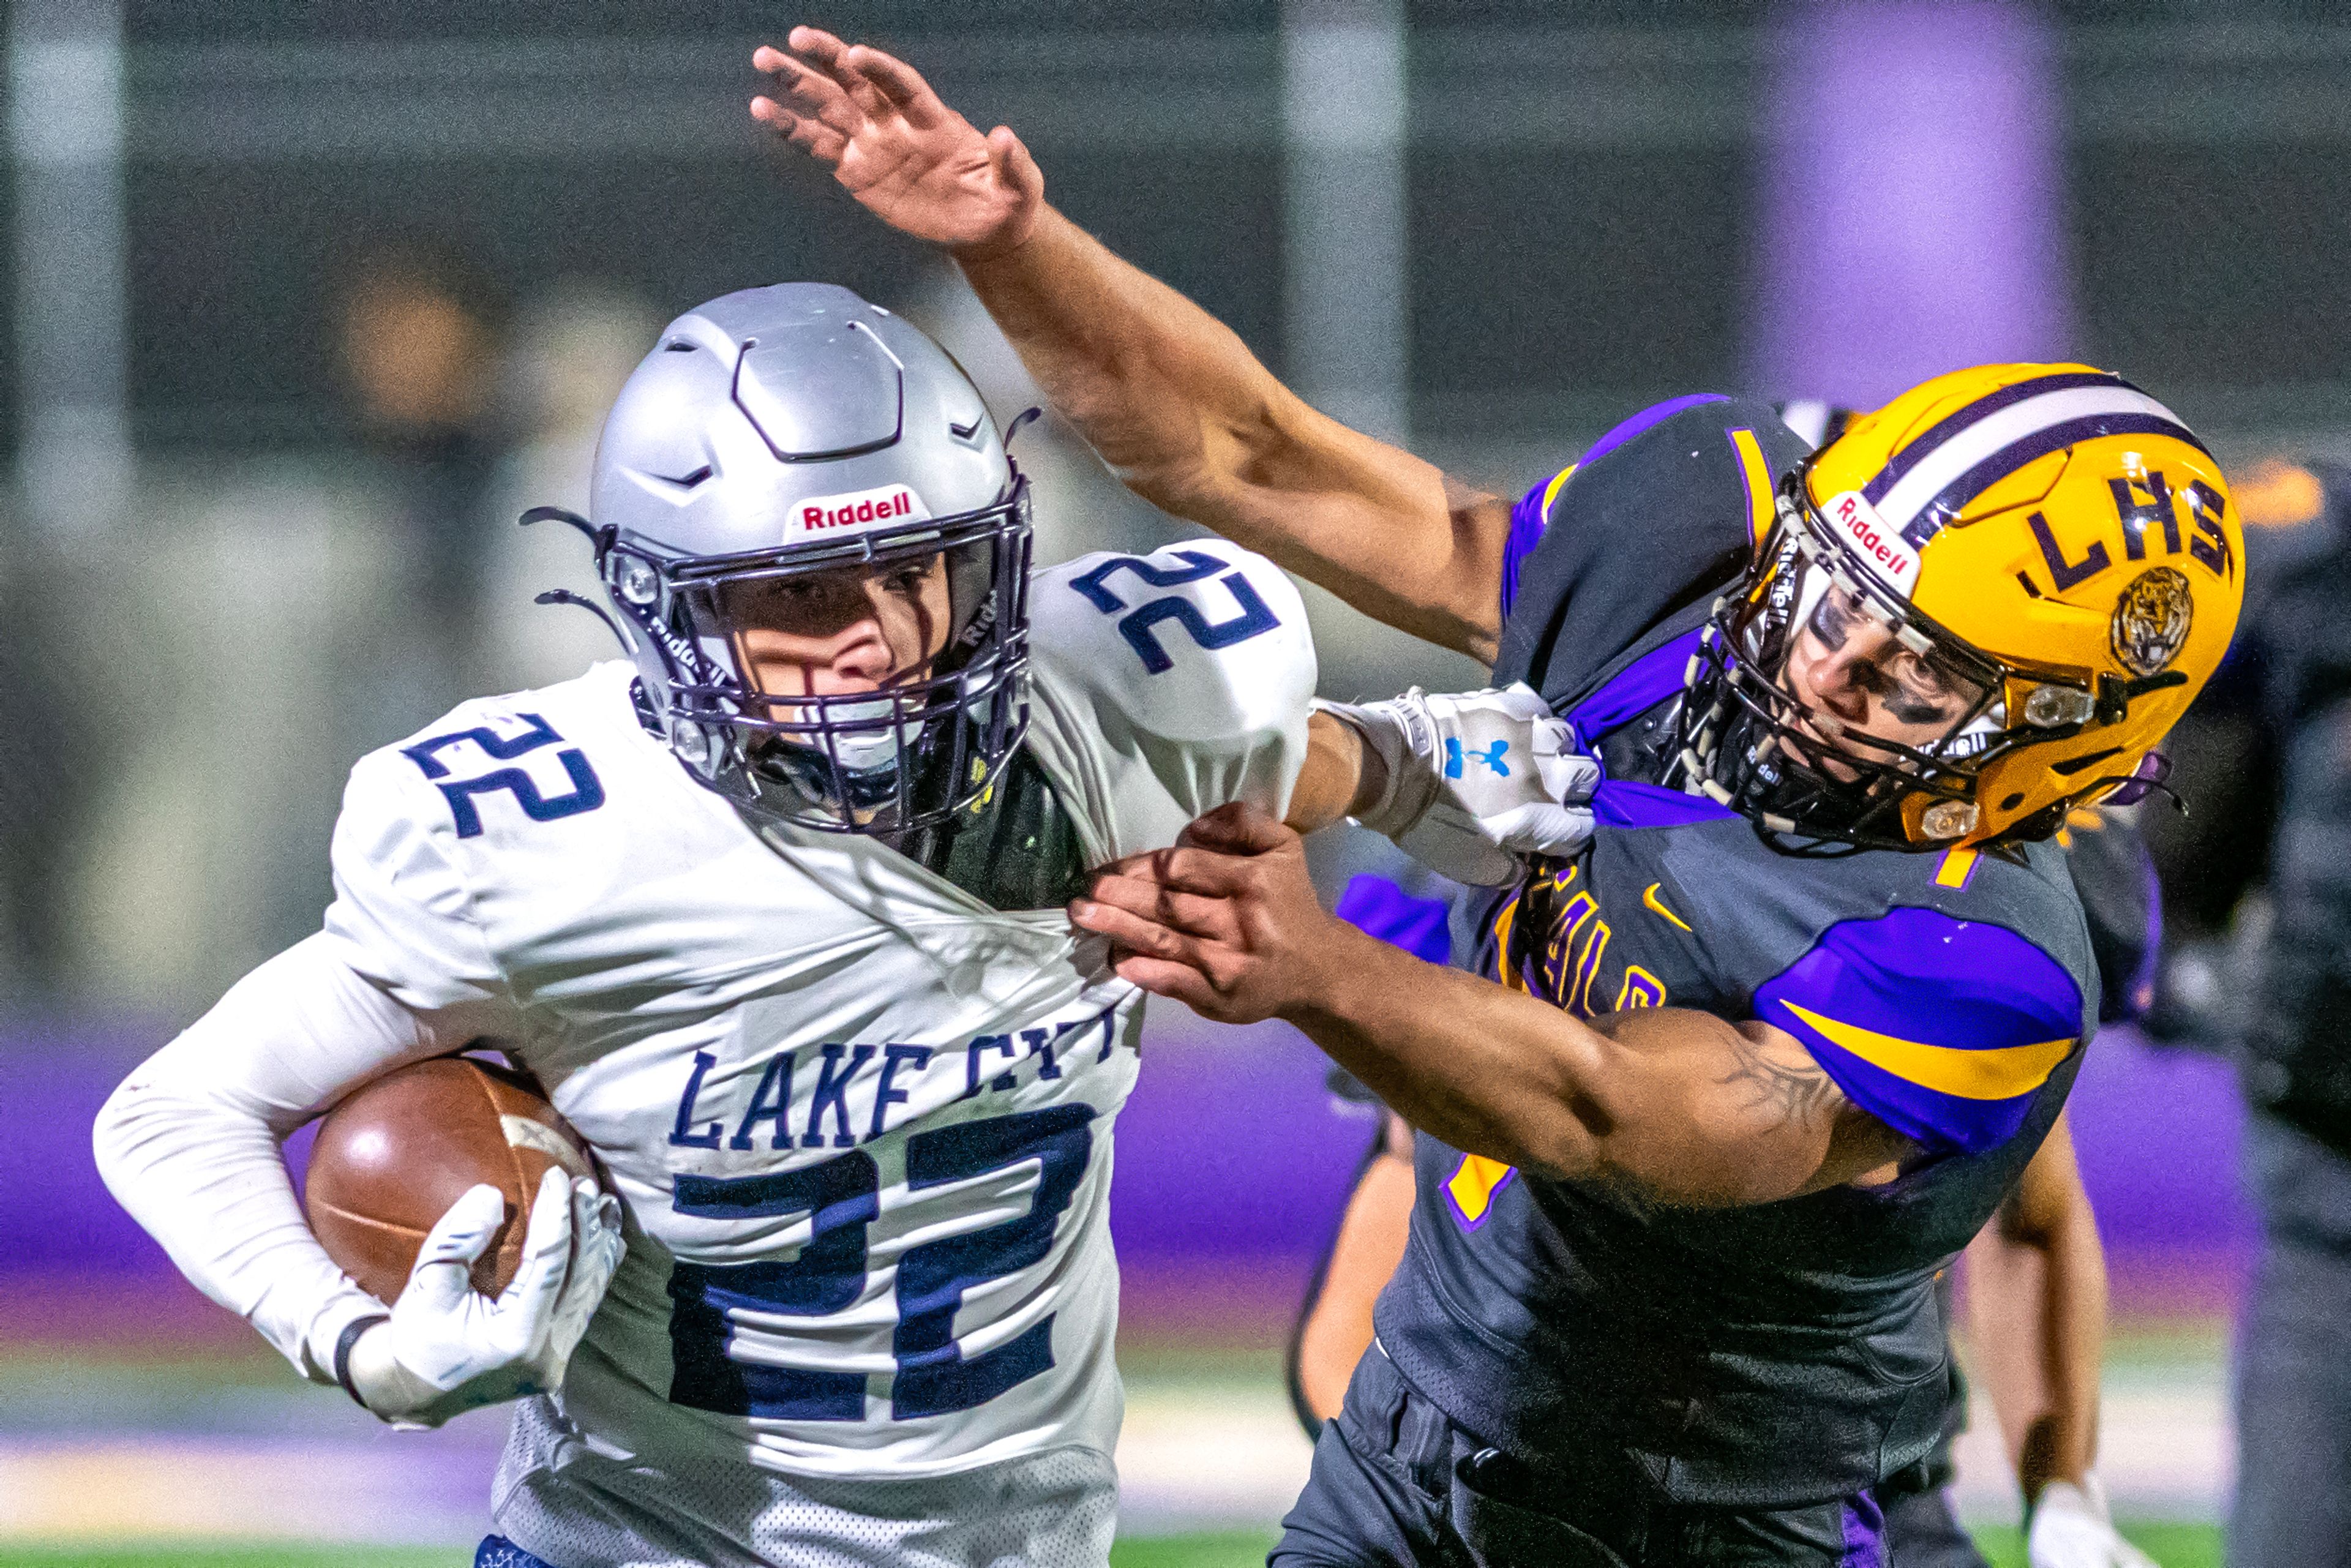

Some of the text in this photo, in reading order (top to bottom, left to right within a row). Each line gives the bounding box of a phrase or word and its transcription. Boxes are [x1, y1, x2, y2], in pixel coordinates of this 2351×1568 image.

[803, 492, 911, 530] Riddell
[1837, 497, 1908, 575] Riddell
[2027, 471, 2226, 593] LHS
[1068, 550, 1281, 675] 22
[398, 713, 606, 839] 22
[667, 1102, 1098, 1422] 22
